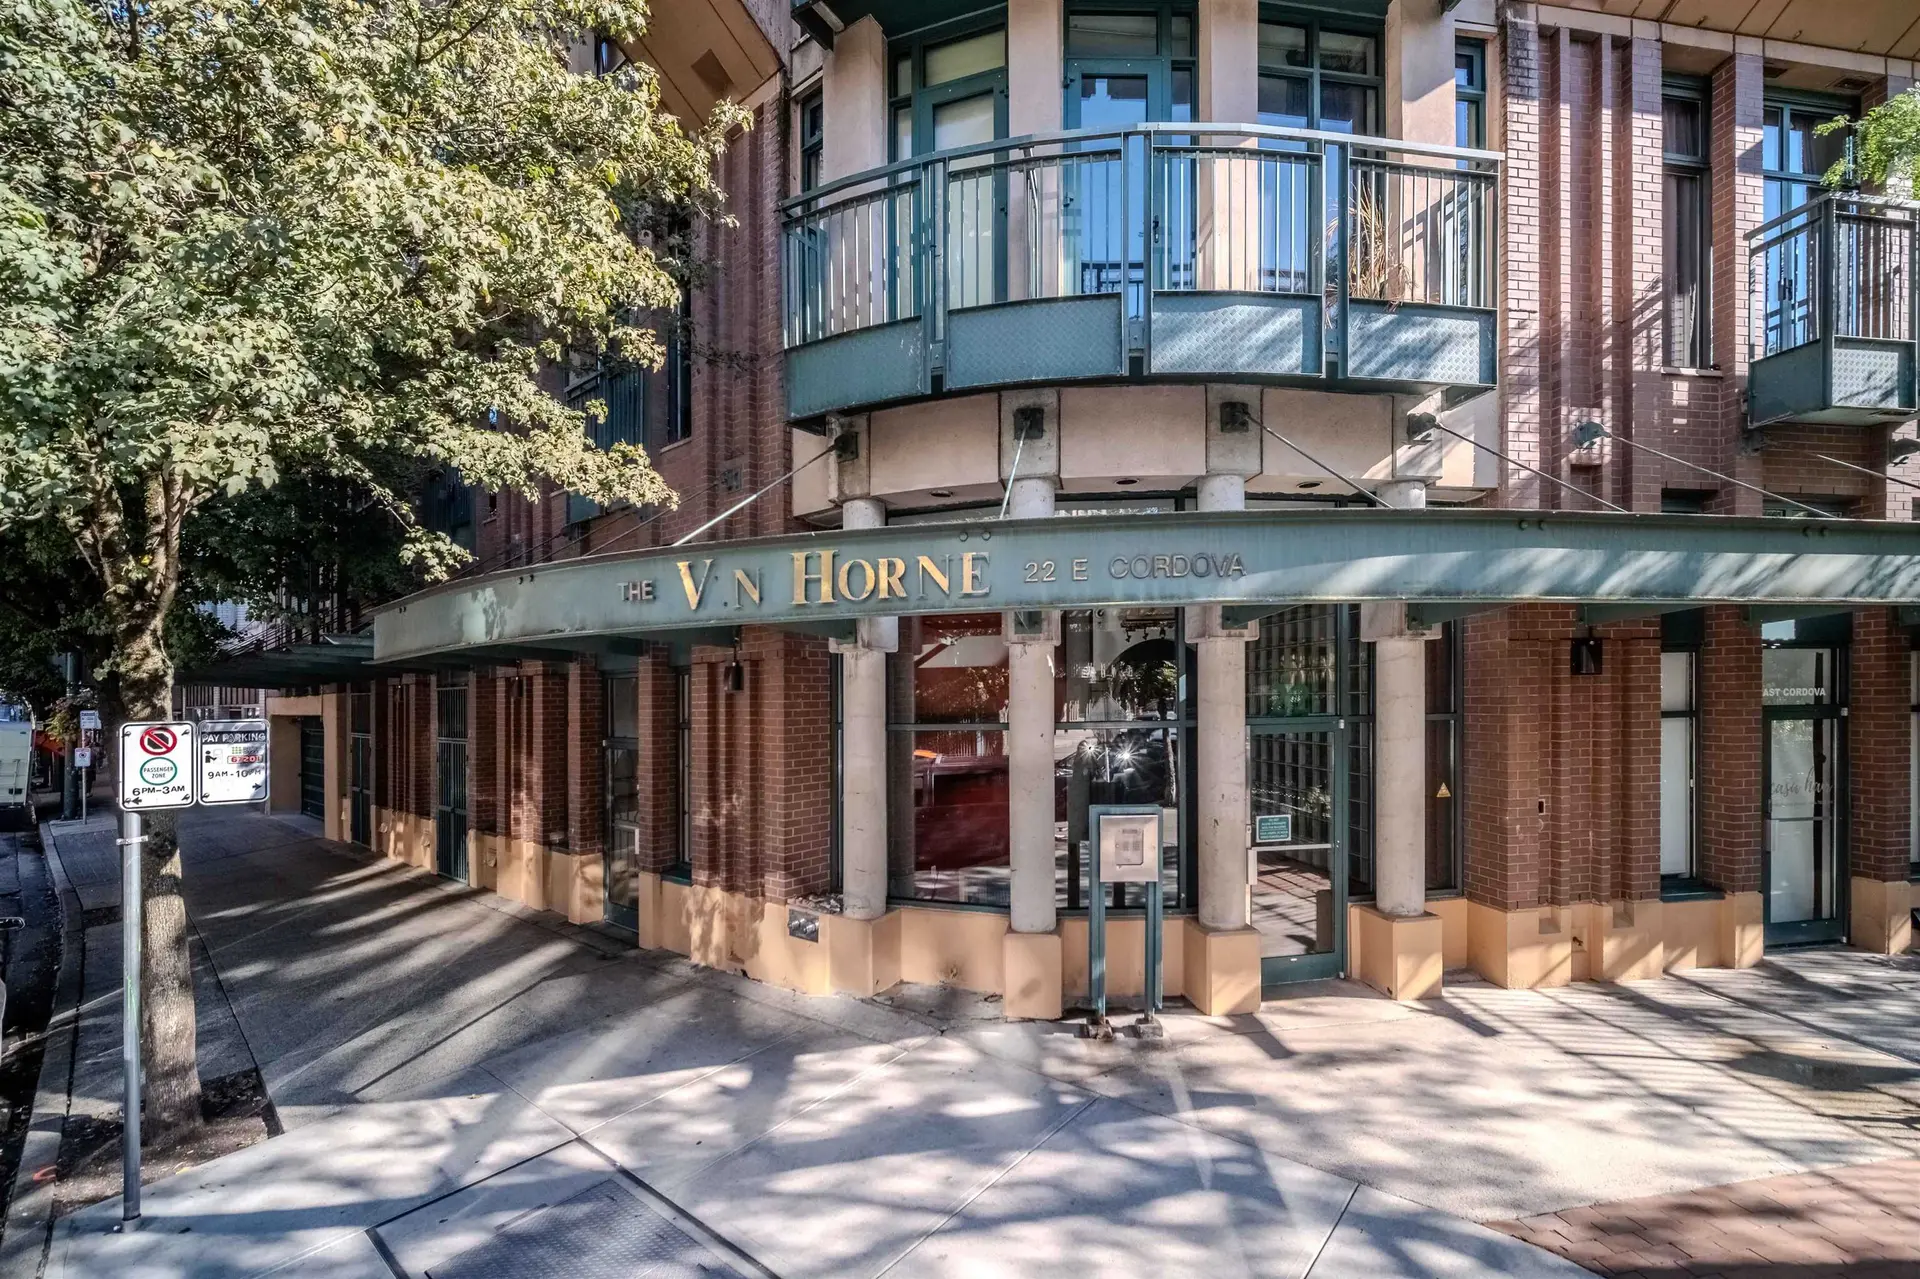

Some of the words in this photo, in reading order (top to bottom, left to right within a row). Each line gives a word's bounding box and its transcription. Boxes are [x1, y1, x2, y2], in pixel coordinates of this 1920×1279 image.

[617, 581, 655, 602] THE
[789, 549, 992, 605] HORNE
[1023, 559, 1057, 584] 22
[1071, 557, 1090, 582] E
[1107, 552, 1248, 580] CORDOVA
[1762, 687, 1781, 697] AST
[1783, 686, 1827, 697] CORDOVA
[201, 734, 219, 743] PAY
[222, 732, 266, 744] PARKING
